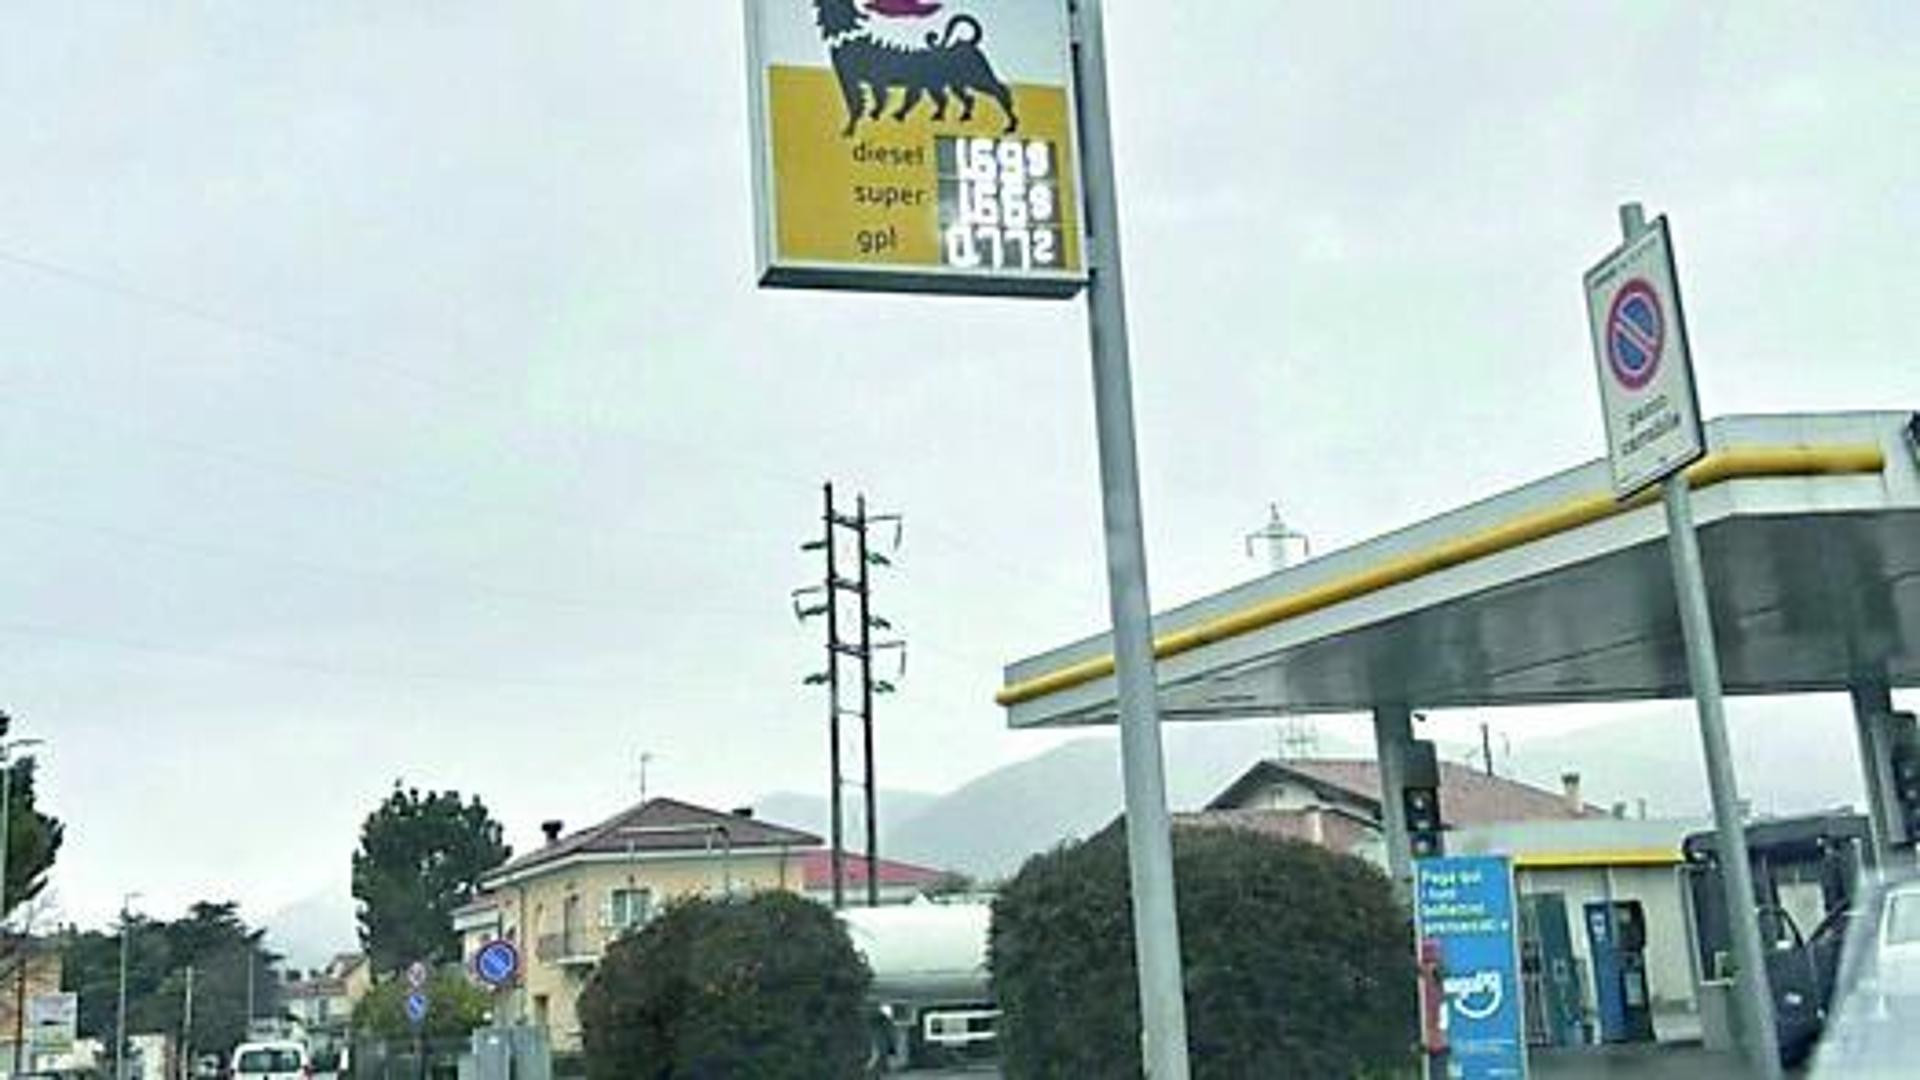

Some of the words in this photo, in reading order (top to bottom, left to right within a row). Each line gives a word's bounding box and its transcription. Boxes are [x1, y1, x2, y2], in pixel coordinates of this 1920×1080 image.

[853, 142, 925, 165] diesel
[853, 185, 926, 208] super
[856, 227, 898, 253] gpl
